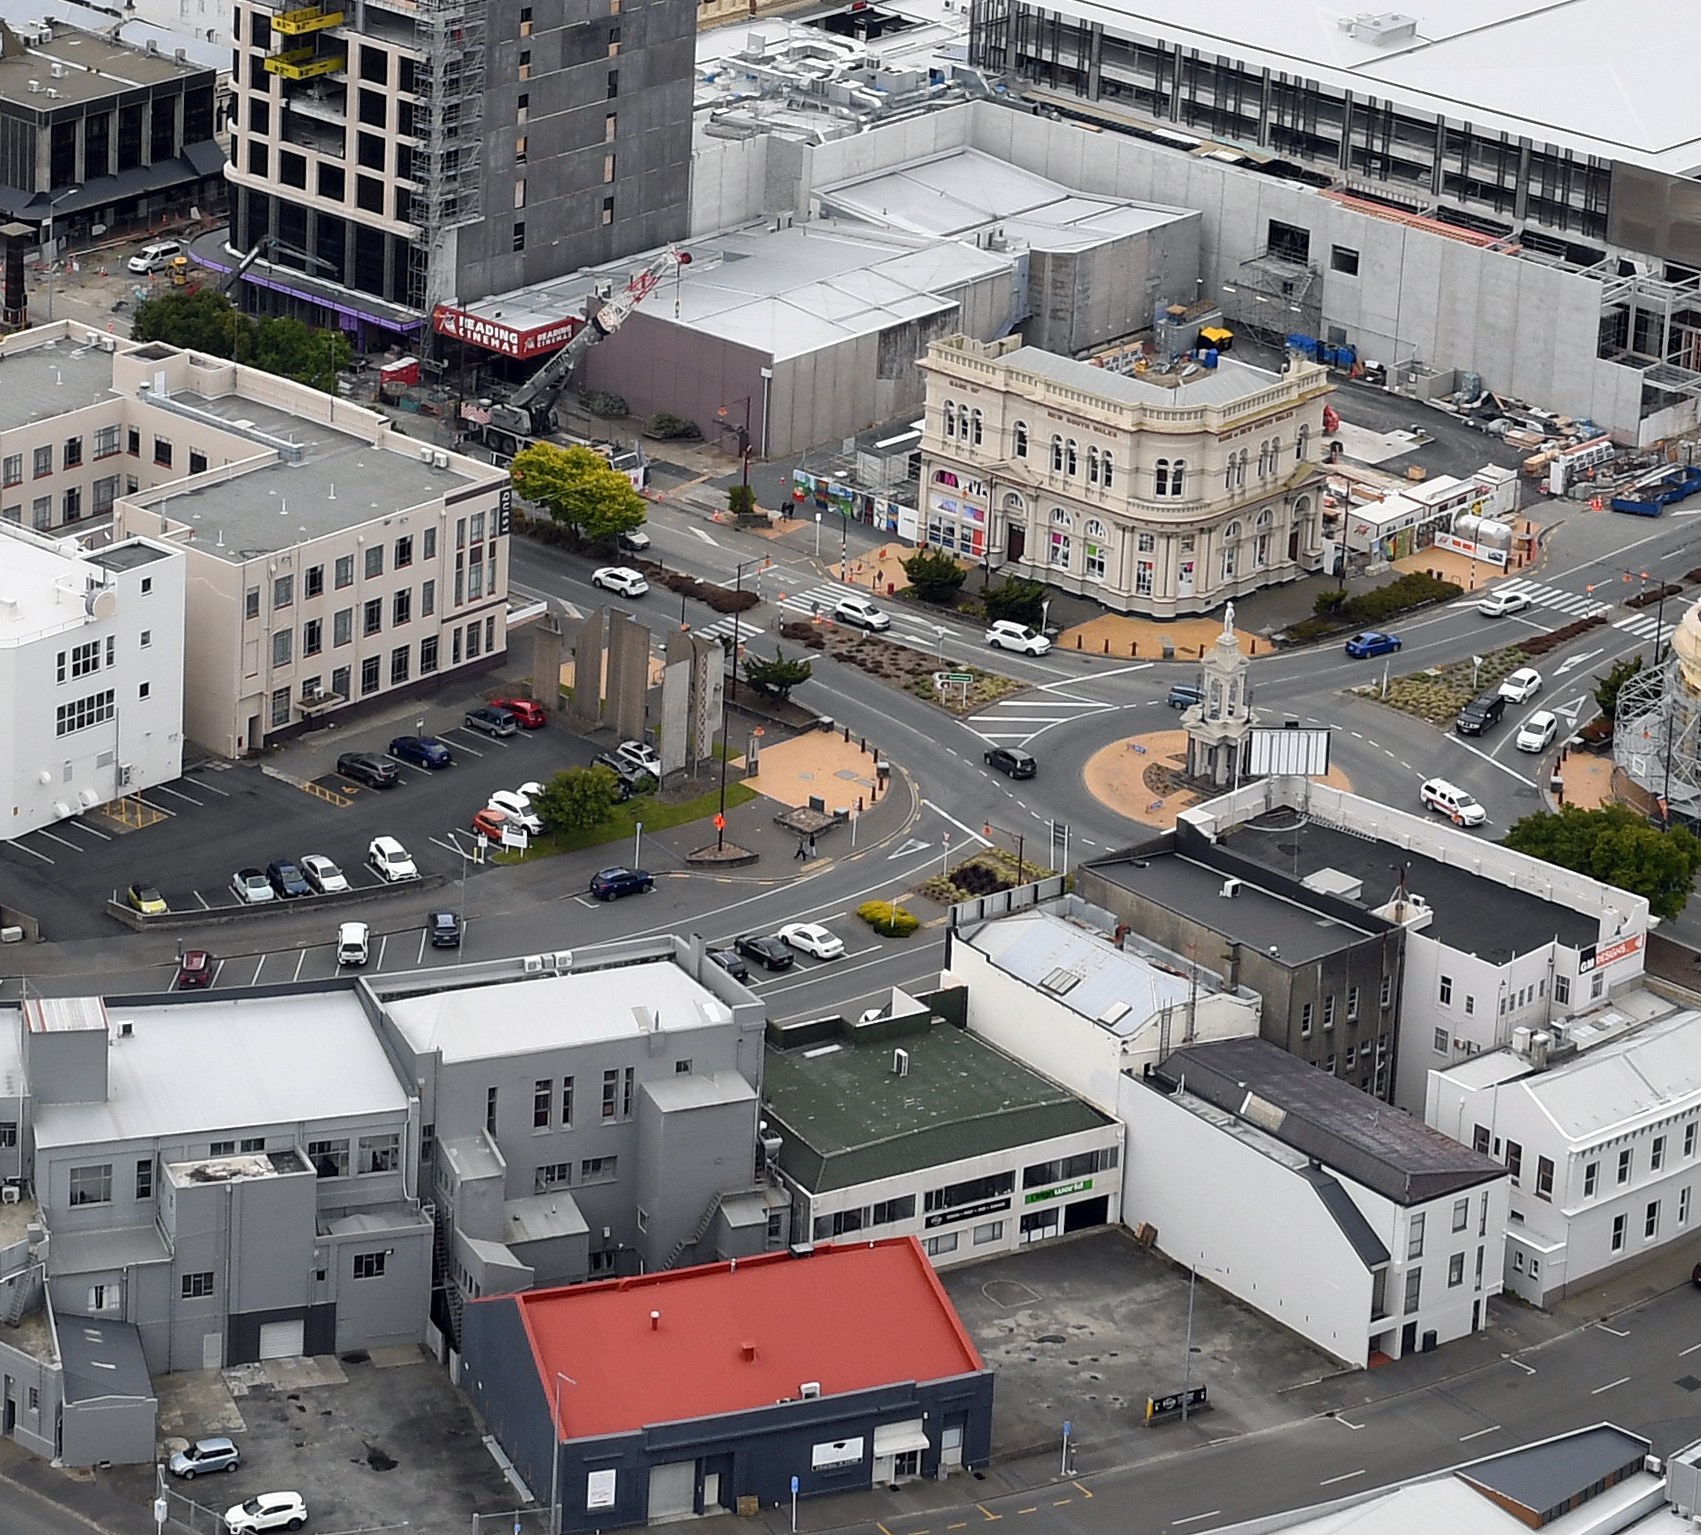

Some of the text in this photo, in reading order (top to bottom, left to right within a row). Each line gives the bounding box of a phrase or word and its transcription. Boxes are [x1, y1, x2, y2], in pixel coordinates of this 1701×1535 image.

[458, 315, 519, 345] READING
[458, 328, 518, 354] CINEMAS
[536, 324, 573, 342] READING
[536, 332, 573, 349] CINEMAS
[1048, 410, 1118, 438] NEW SOUTH WALES
[1218, 433, 1233, 444] BANK
[1240, 425, 1253, 436] NEW
[1275, 411, 1294, 423] WALES
[501, 492, 511, 532] QUEST
[1580, 958, 1595, 973] GM
[1596, 943, 1626, 964] DESIGNS
